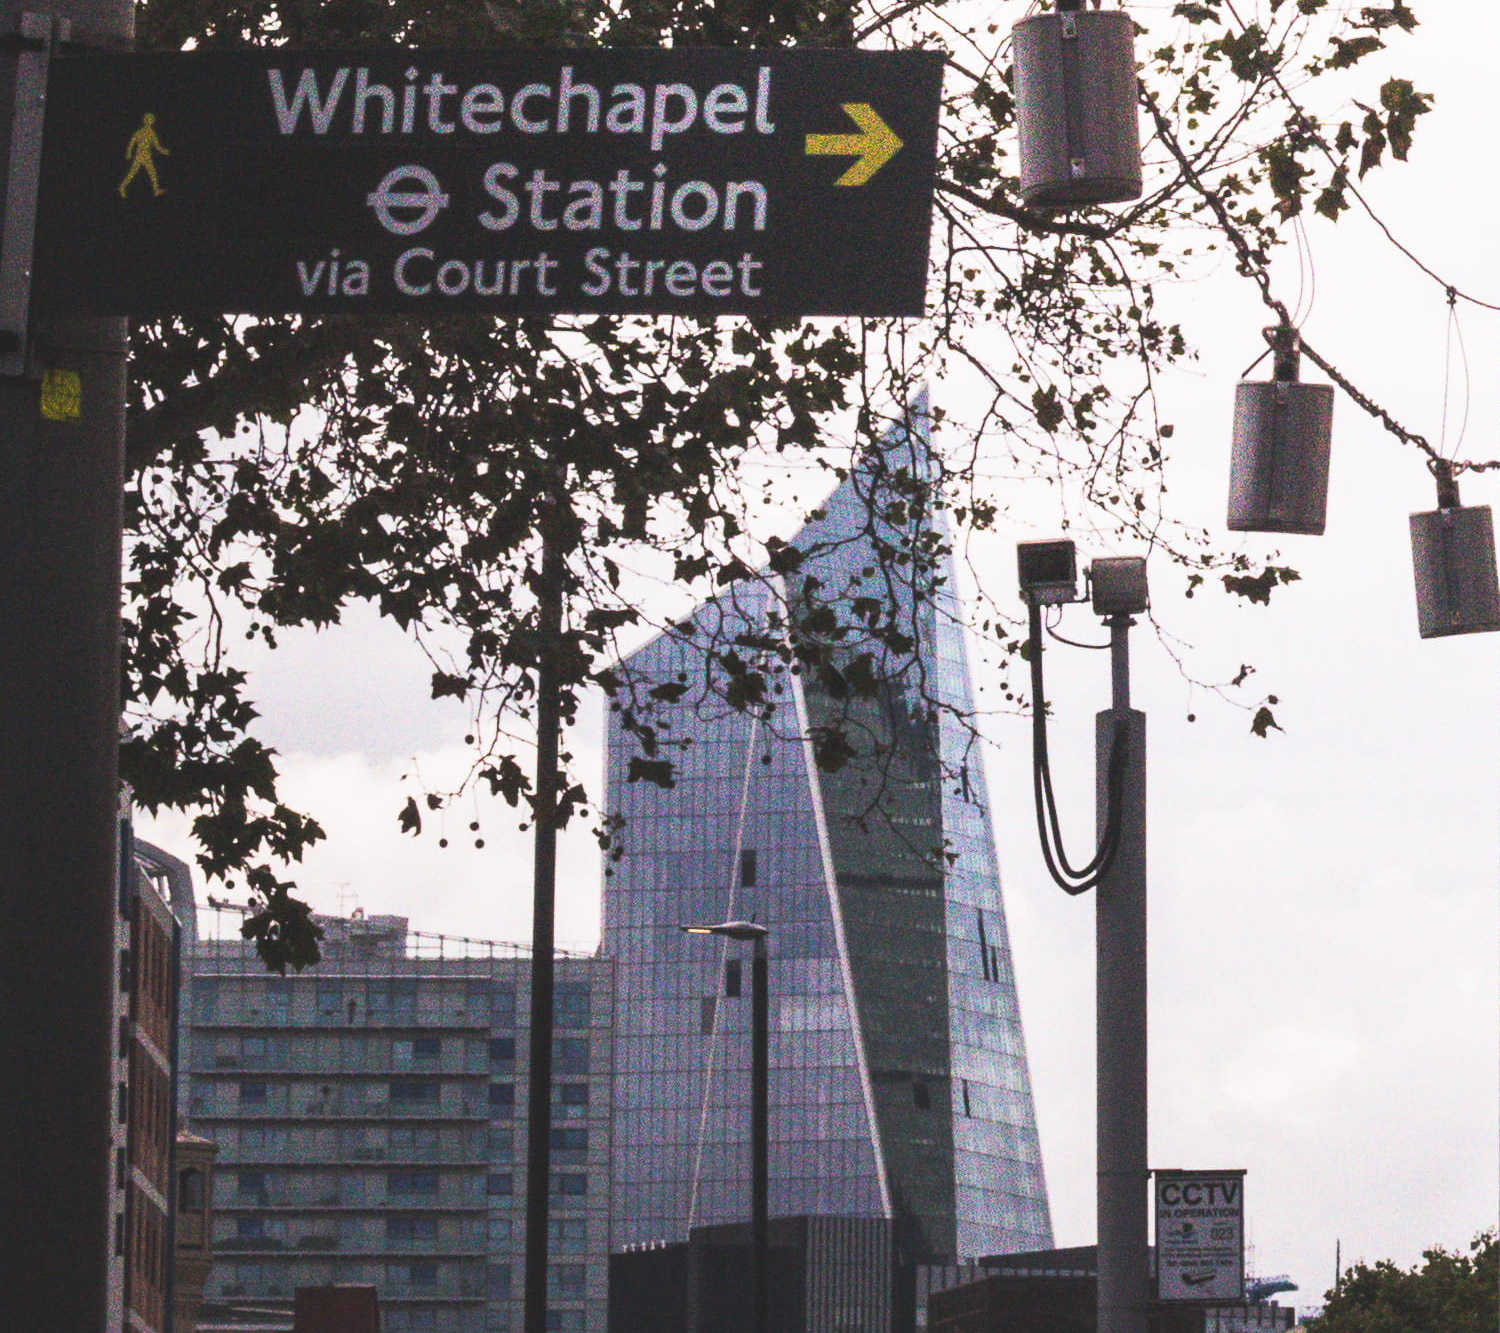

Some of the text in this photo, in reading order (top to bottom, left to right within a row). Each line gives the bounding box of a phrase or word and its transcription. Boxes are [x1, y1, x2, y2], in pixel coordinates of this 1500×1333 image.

[267, 65, 776, 151] Whitechapel
[477, 162, 767, 232] Station
[296, 245, 764, 298] via Court Street
[1160, 1183, 1238, 1206] CCTV
[1174, 1207, 1238, 1218] OPERATION
